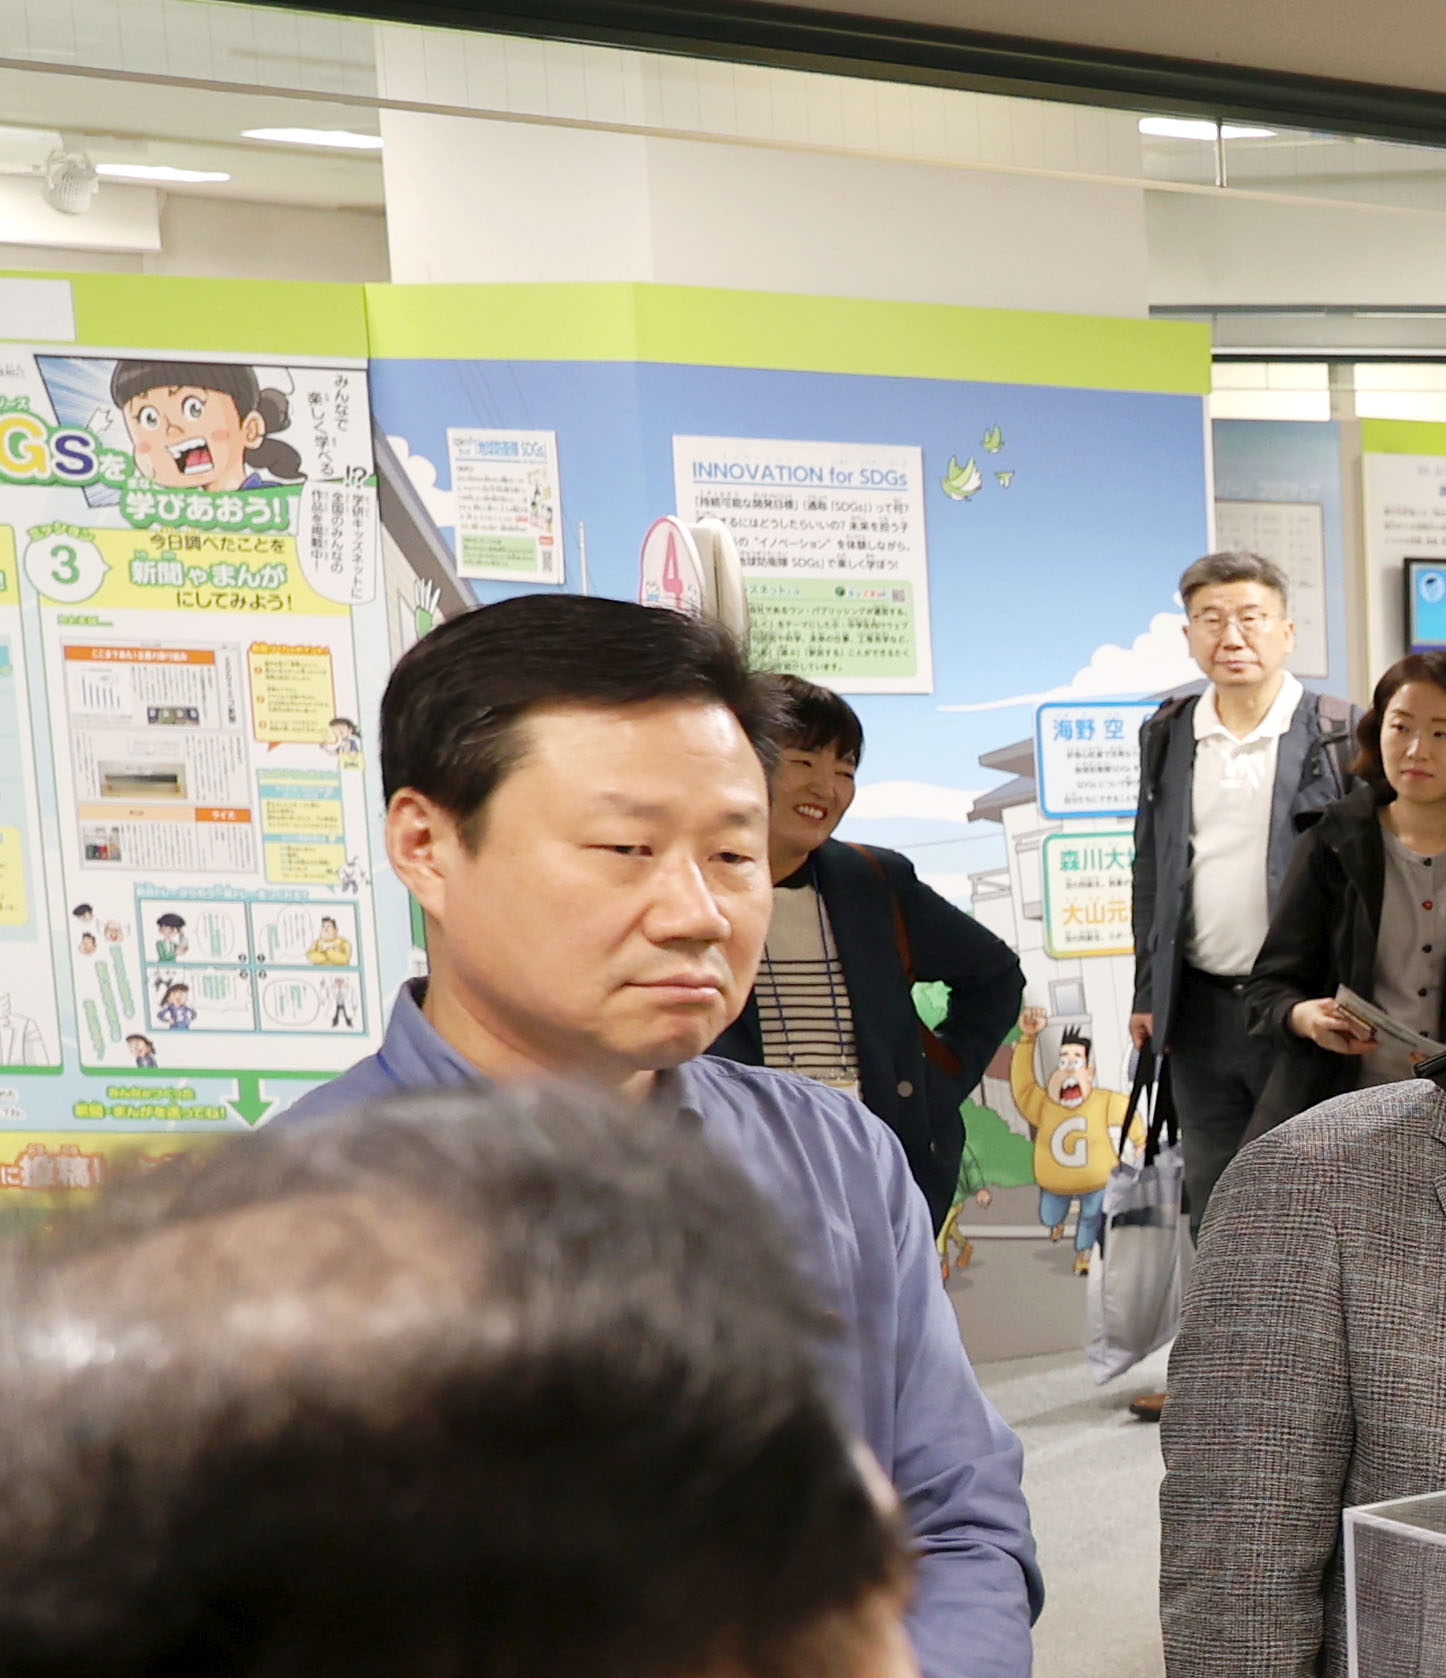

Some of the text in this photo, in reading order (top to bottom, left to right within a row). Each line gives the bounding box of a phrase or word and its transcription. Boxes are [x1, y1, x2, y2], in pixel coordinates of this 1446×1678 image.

[334, 374, 349, 432] みんなで
[307, 391, 334, 478] 楽しく学べる
[692, 461, 909, 488] INNOVATION for SDGs
[126, 491, 284, 525] 学びあおう!
[150, 534, 285, 554] 今日調べたことを
[331, 491, 344, 575] 全国のみんなの
[351, 493, 365, 600] 学研キッズネットに
[50, 545, 79, 584] 3
[130, 560, 287, 588] 新聞やまんが
[176, 592, 293, 612] にしてみよう!
[1053, 717, 1126, 742] 海野 空
[1050, 1115, 1089, 1169] G
